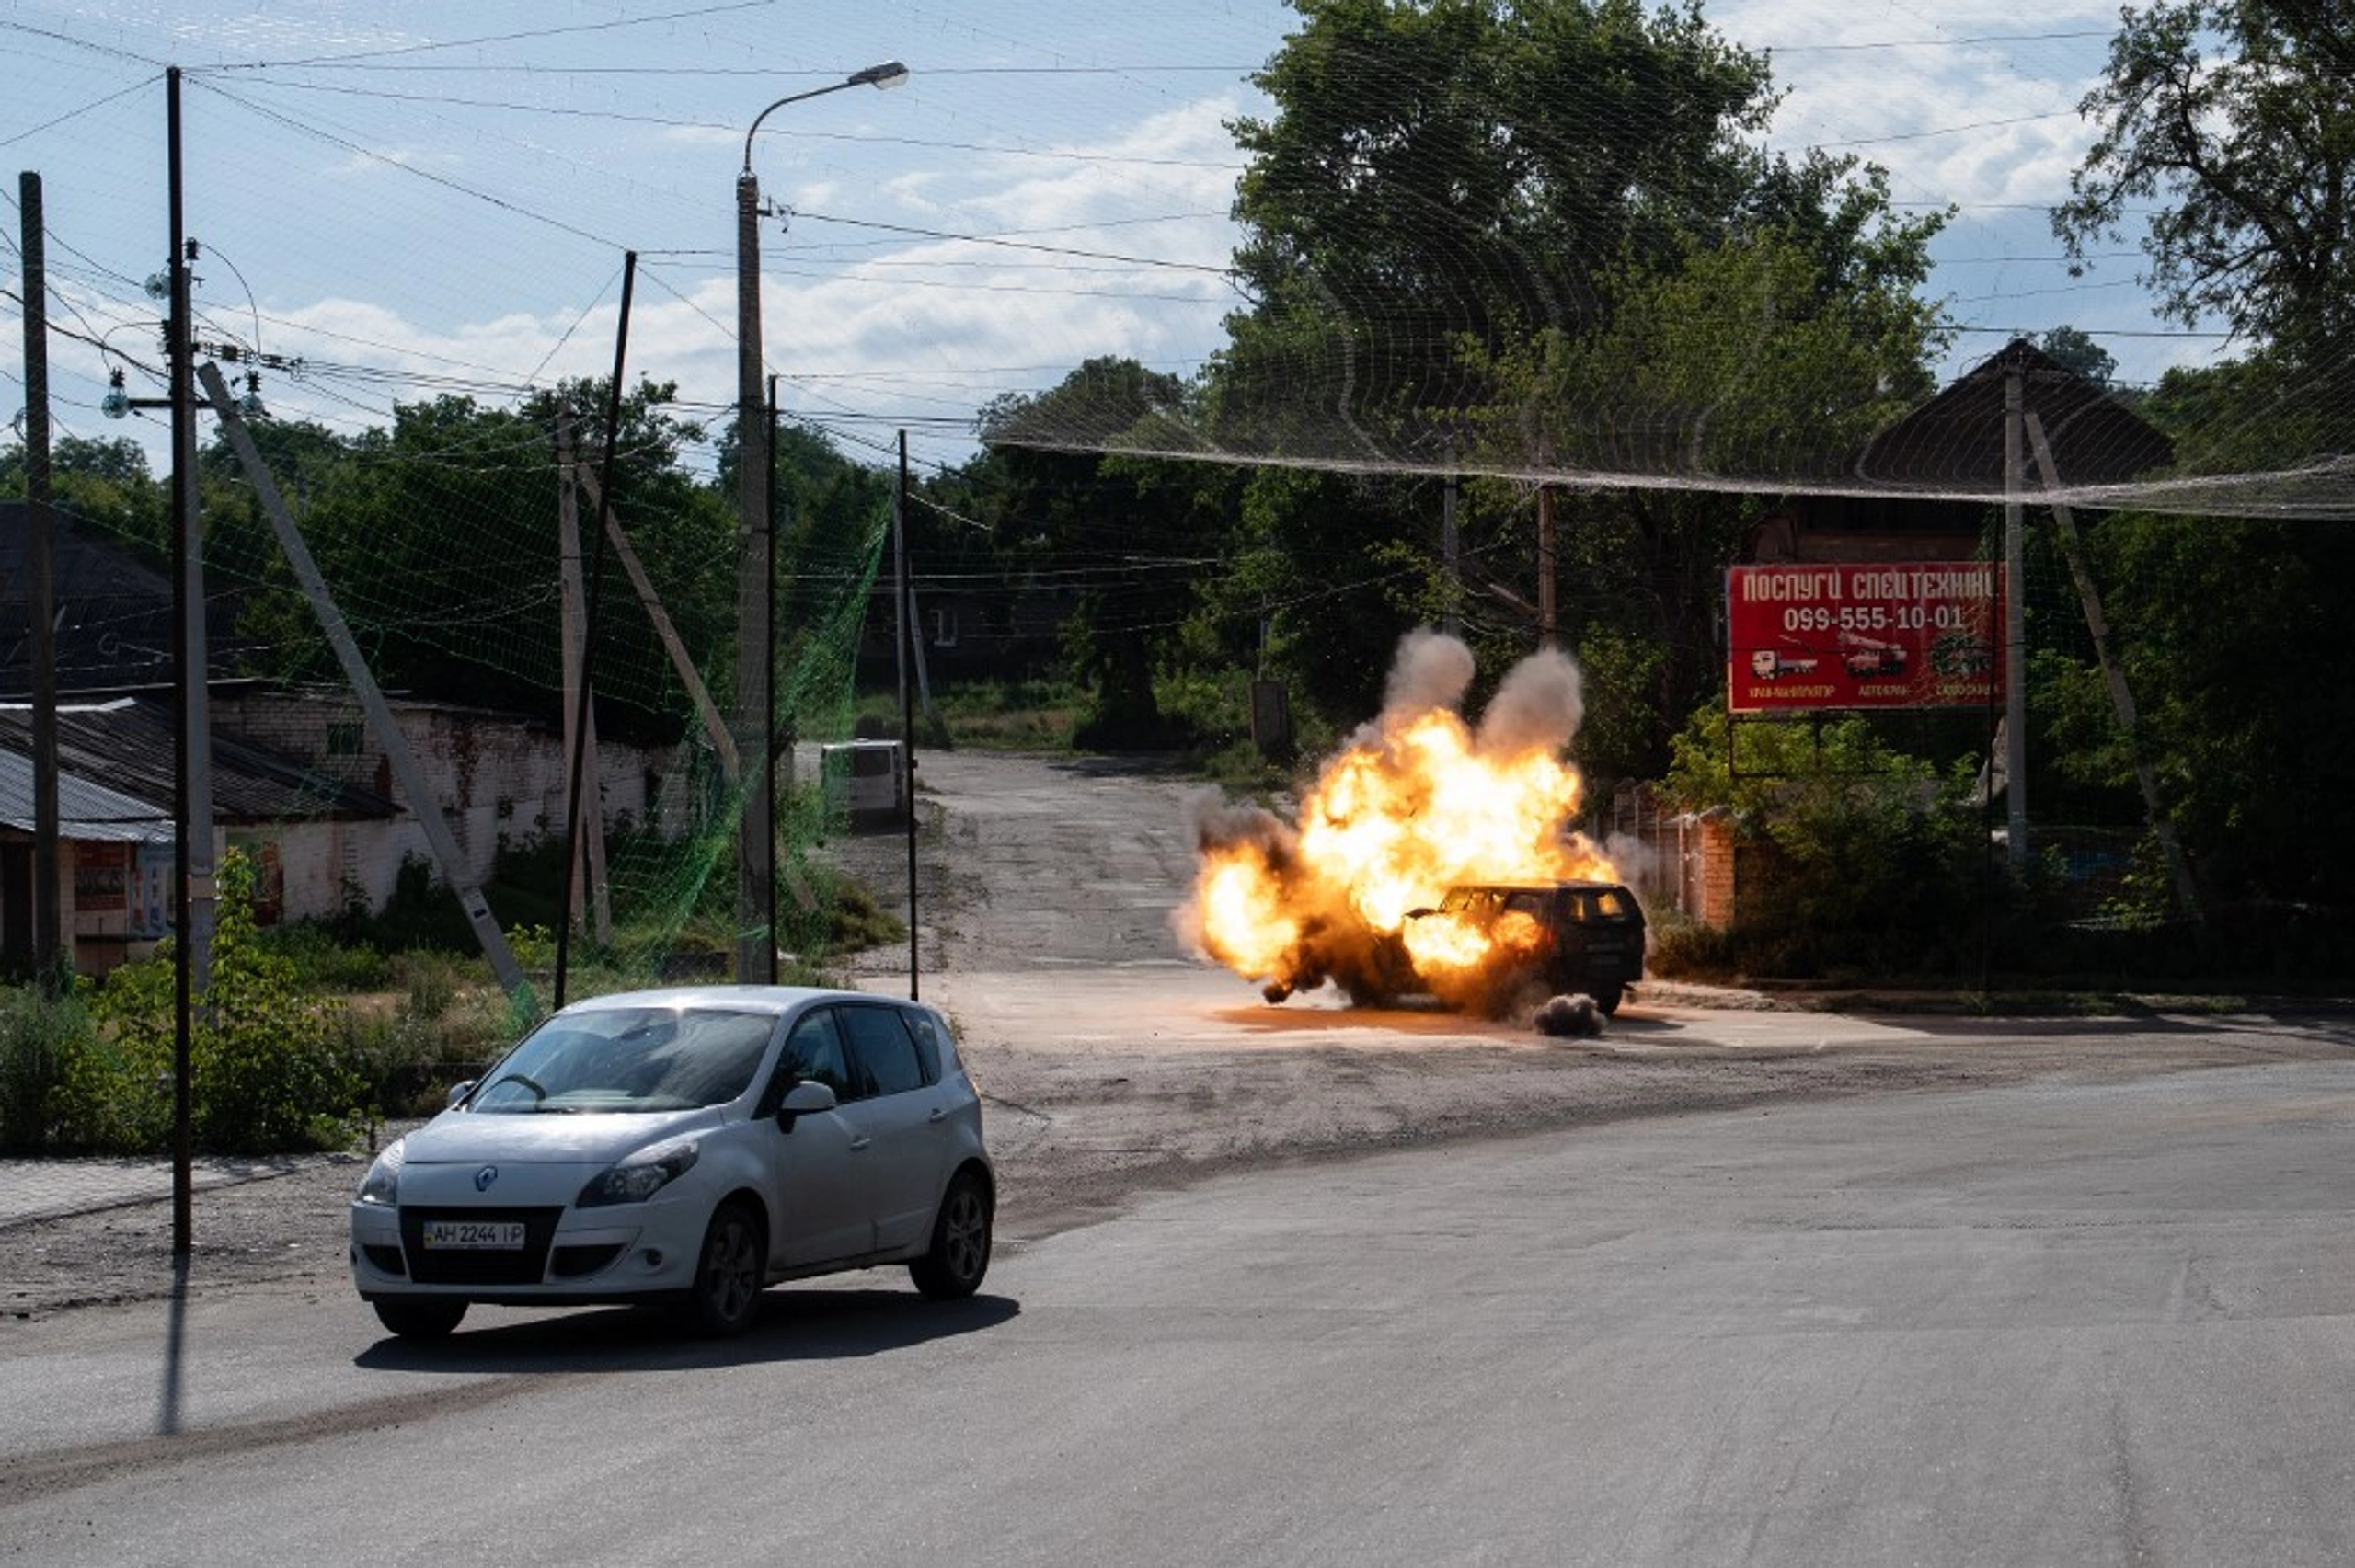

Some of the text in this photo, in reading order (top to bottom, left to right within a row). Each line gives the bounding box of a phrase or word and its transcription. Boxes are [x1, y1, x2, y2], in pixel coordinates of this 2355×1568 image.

[1743, 572, 1843, 602] ПОСЛУГИ
[1783, 604, 1965, 631] 099-555-10-01
[435, 1225, 456, 1242] AH
[460, 1225, 496, 1242] 2244
